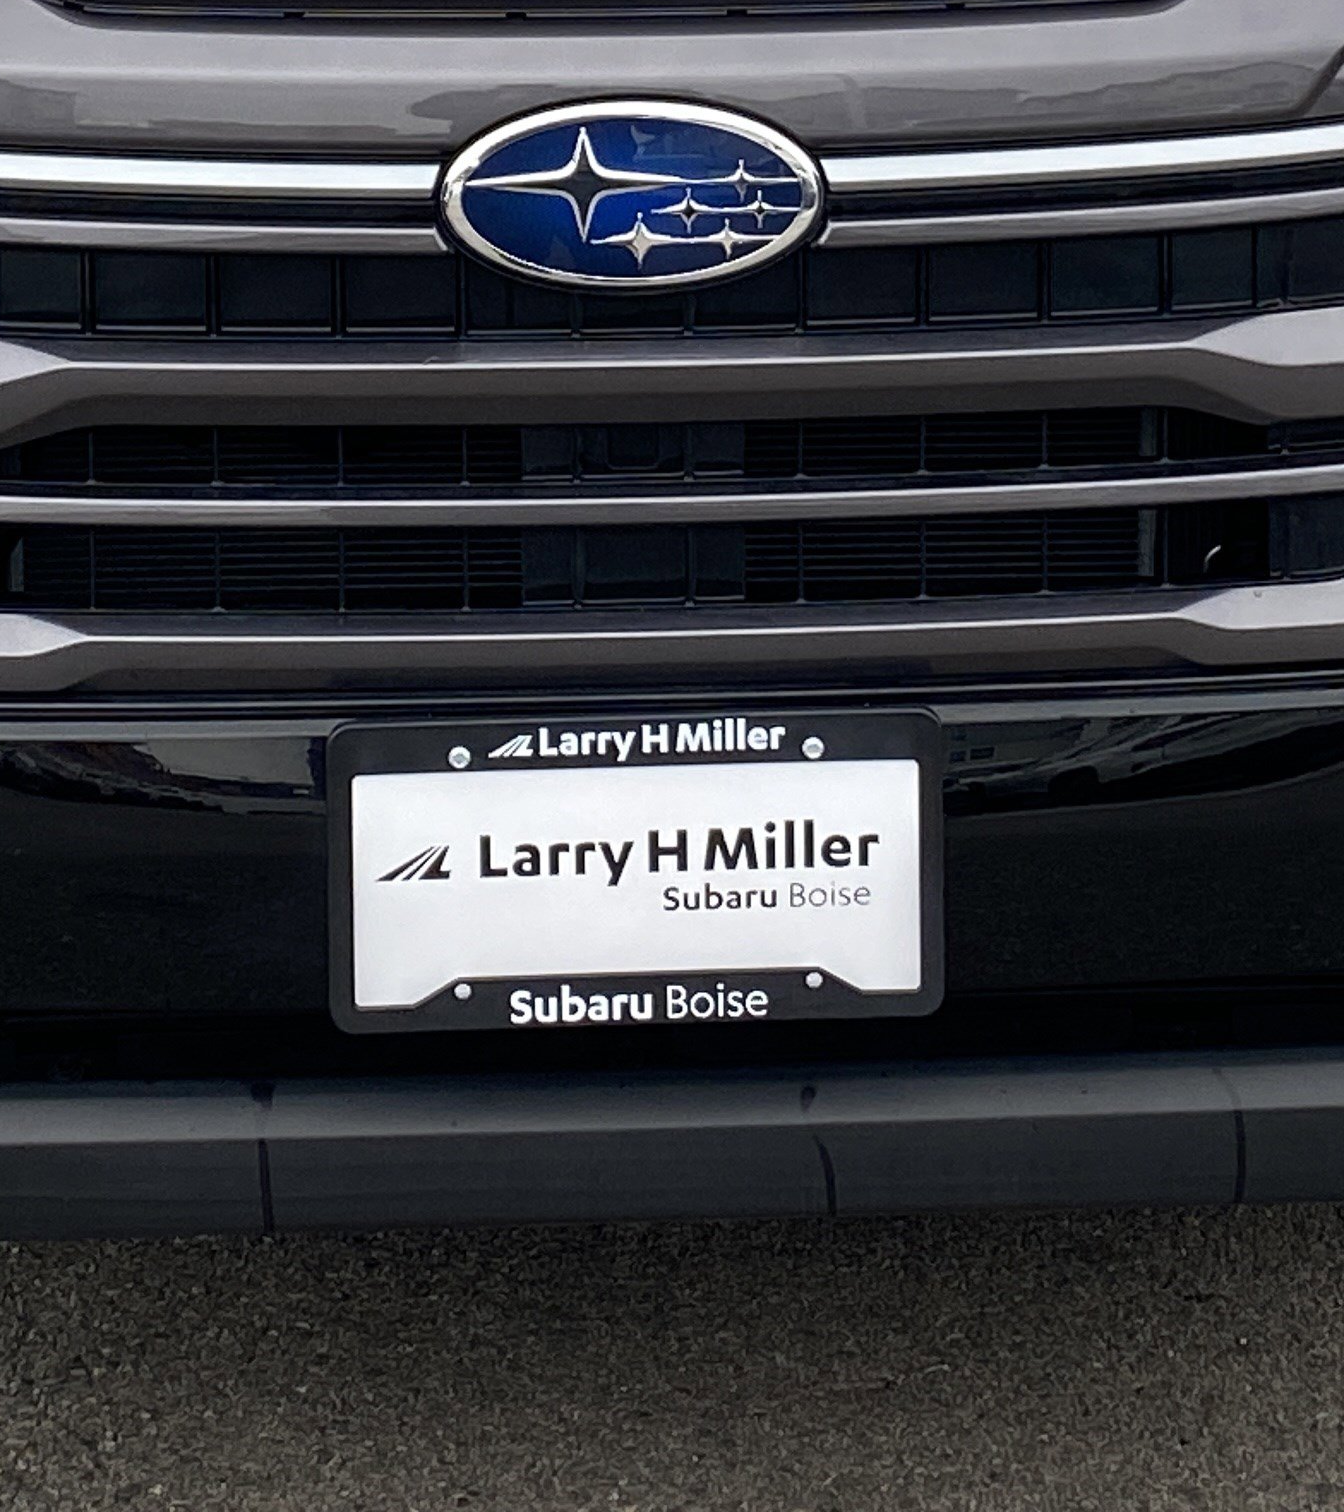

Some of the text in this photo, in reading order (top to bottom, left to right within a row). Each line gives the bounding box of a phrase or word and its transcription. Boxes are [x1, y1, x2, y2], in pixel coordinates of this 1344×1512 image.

[539, 718, 786, 761] Larry H Miller
[478, 820, 880, 886] Larry H Miller
[662, 881, 872, 912] Subaru Boise
[509, 982, 769, 1025] Subaru Boise
